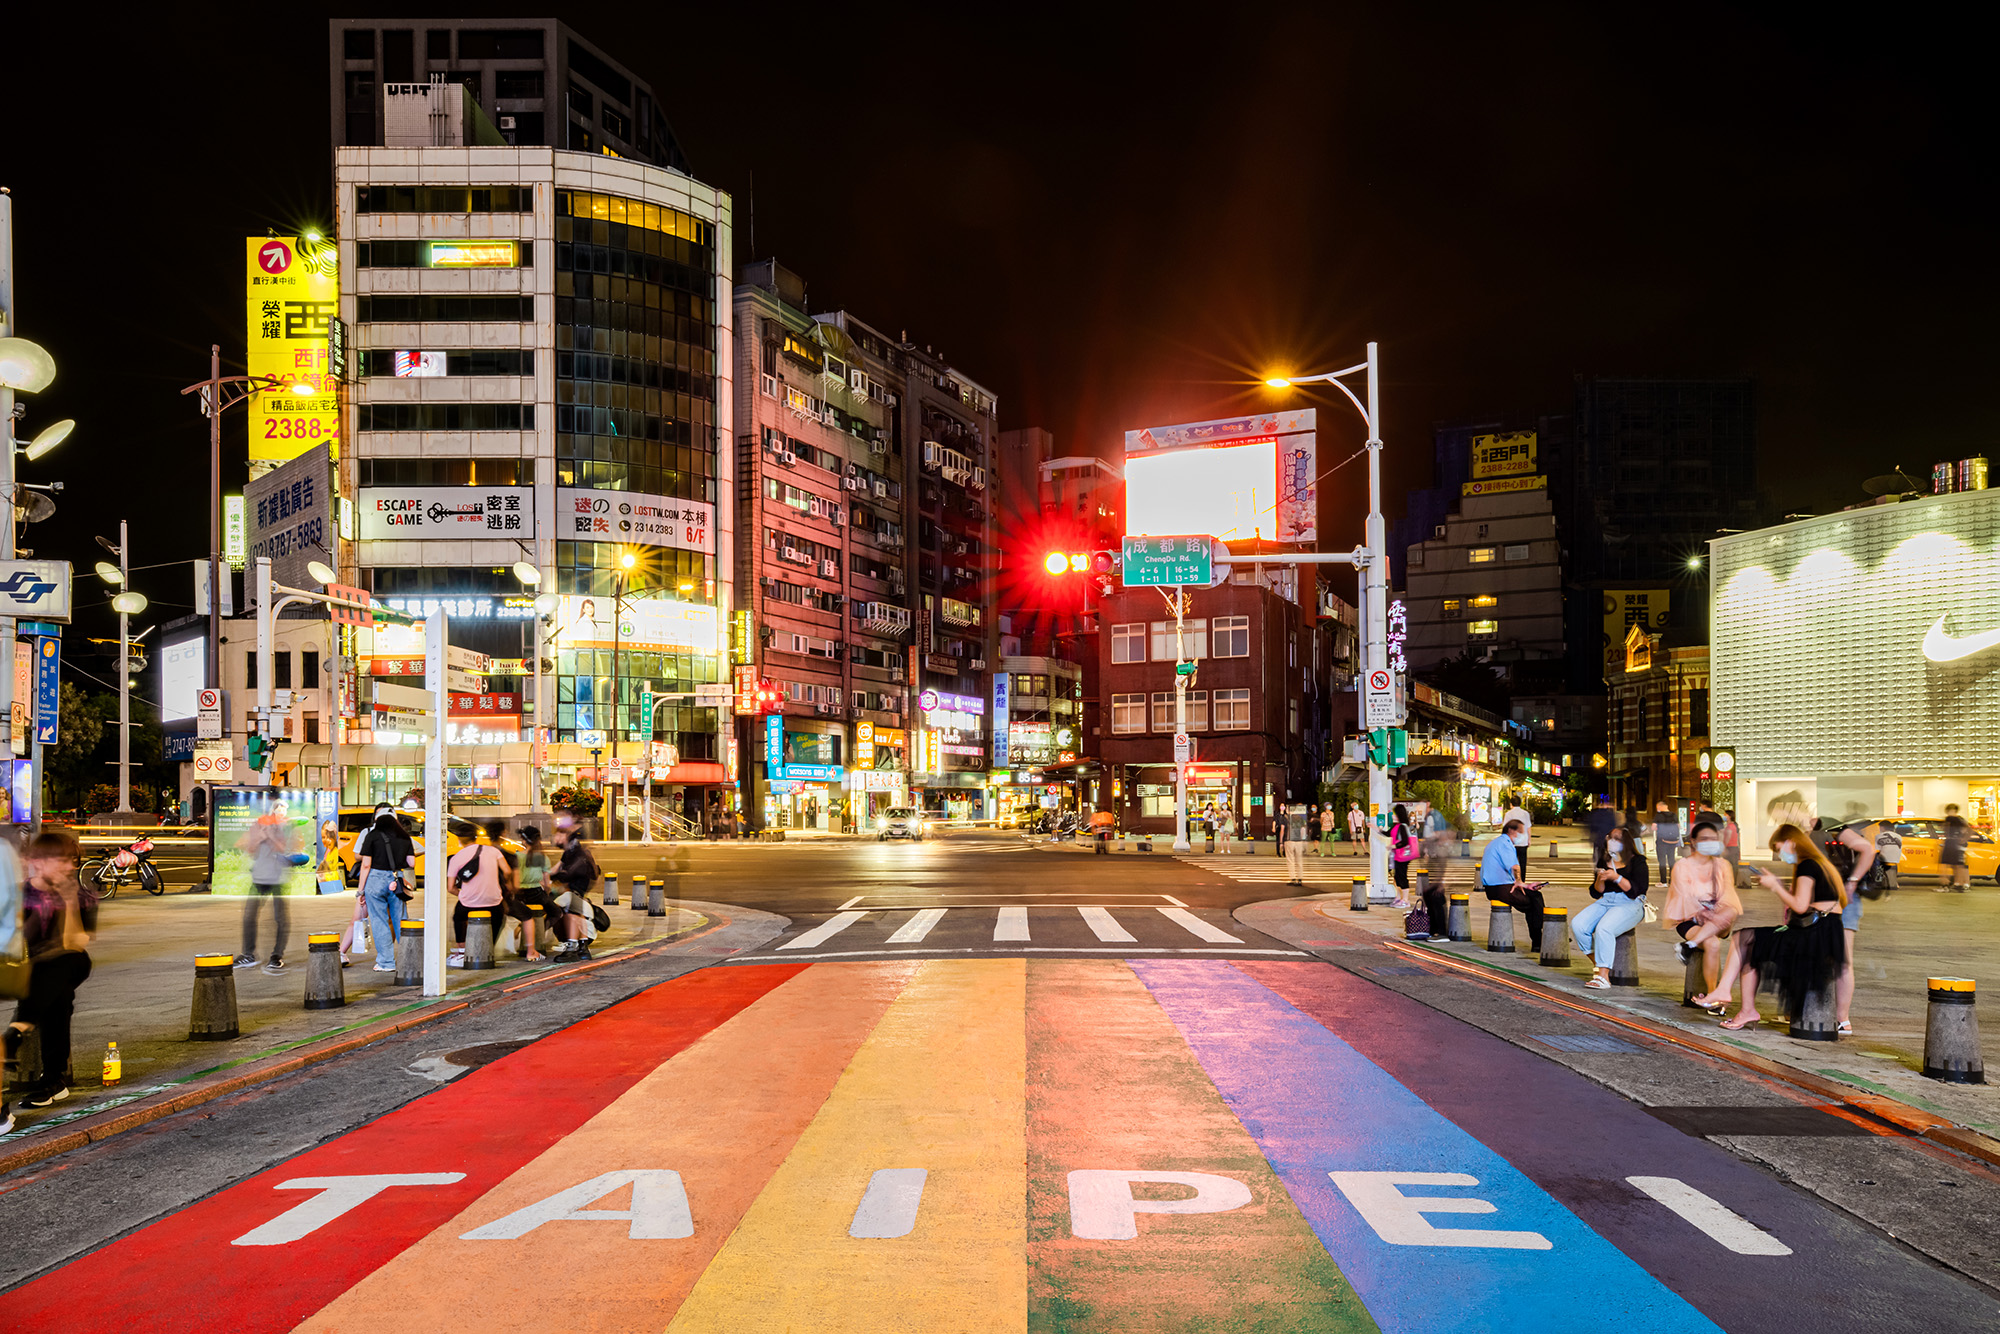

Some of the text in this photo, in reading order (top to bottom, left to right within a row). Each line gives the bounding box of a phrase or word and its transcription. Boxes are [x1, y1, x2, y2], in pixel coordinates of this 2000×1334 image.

[262, 300, 281, 339] 榮耀
[1481, 461, 1529, 473] 2388-2288
[376, 499, 422, 511] ESCAPE
[487, 495, 520, 511] 密室
[386, 513, 423, 525] GAME
[634, 505, 679, 520] LOSTTW.COM
[686, 527, 705, 544] 6/F
[1133, 538, 1201, 554] 成都路
[1144, 554, 1191, 564] ChengDu Rd.
